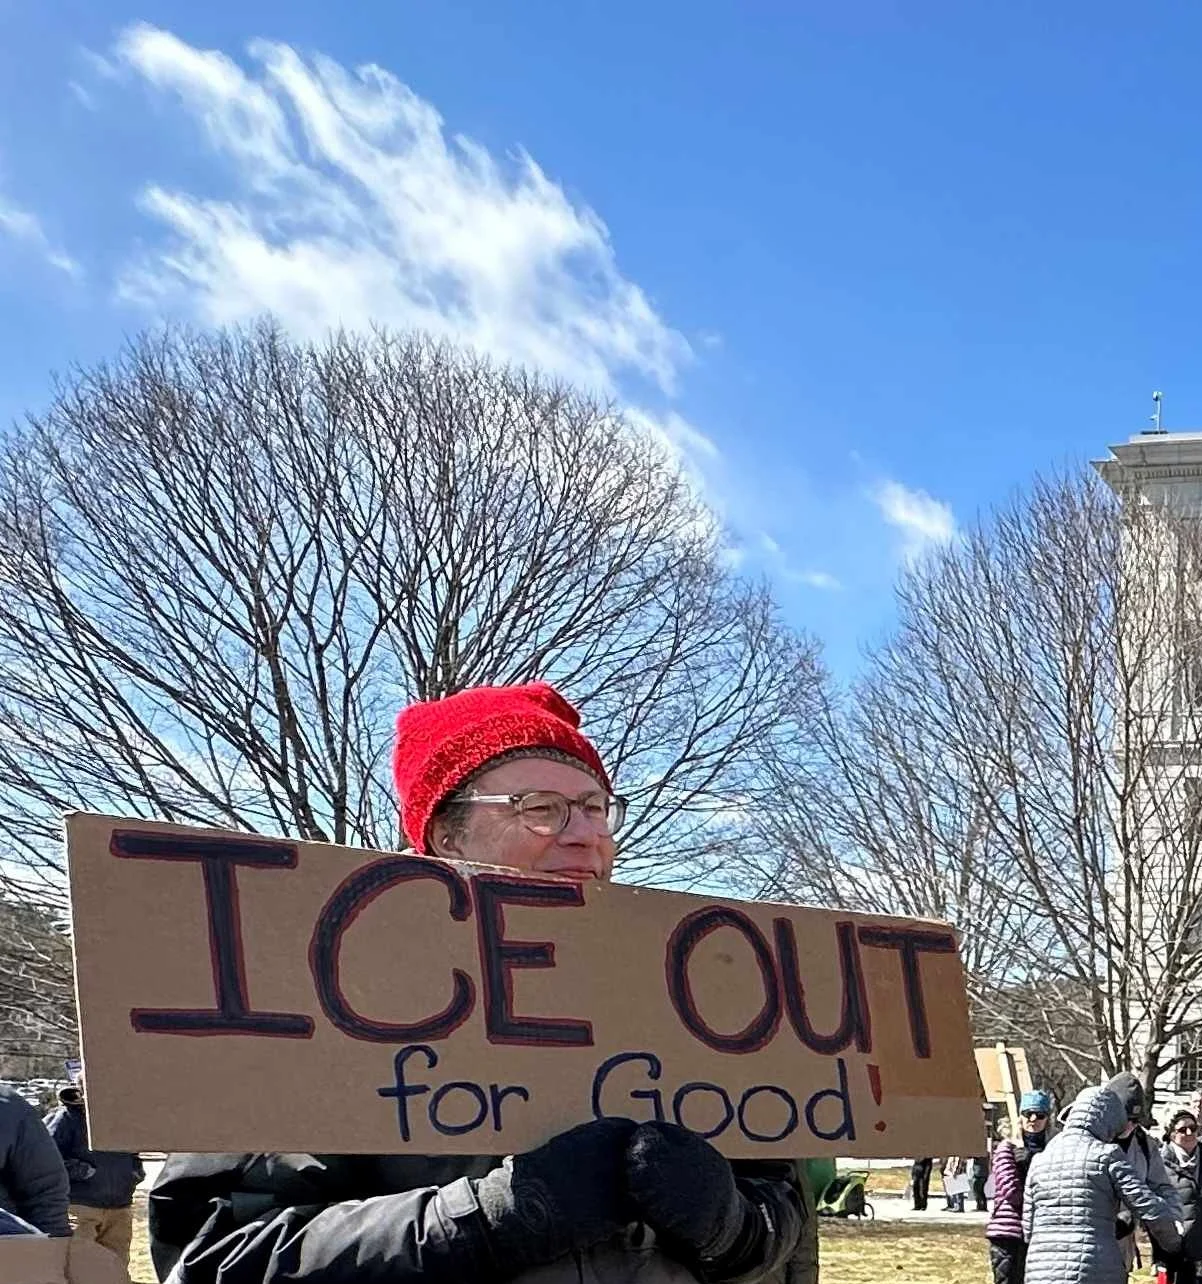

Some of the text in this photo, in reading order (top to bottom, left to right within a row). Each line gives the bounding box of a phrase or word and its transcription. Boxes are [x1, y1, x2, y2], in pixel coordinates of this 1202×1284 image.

[110, 828, 957, 1059] ICE OUT
[379, 1044, 887, 1143] for Good!
